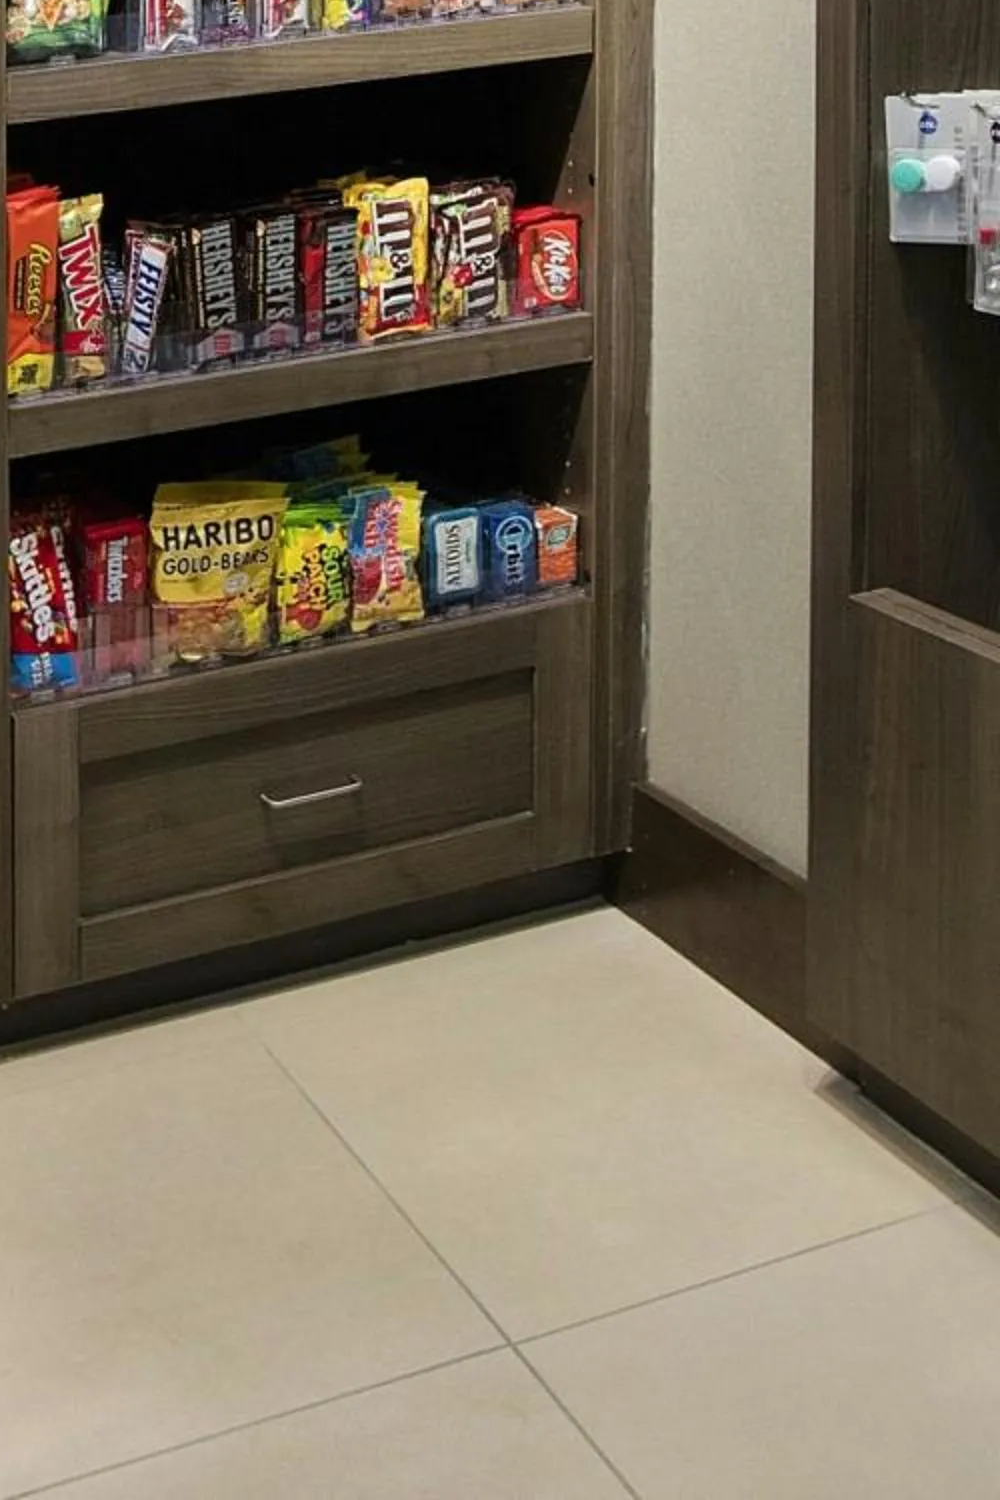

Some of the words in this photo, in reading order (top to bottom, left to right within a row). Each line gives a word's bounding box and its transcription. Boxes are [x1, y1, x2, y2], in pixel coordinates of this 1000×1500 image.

[131, 259, 162, 336] FEISTY
[202, 219, 237, 329] HERSHEY'S
[265, 213, 297, 321] HERSHEY'S
[161, 515, 275, 551] HARIBO
[161, 547, 270, 576] GOLD-BEARS
[443, 524, 462, 586] ALTOIDS
[10, 533, 55, 642] Skittles
[321, 545, 344, 603] SOUR
